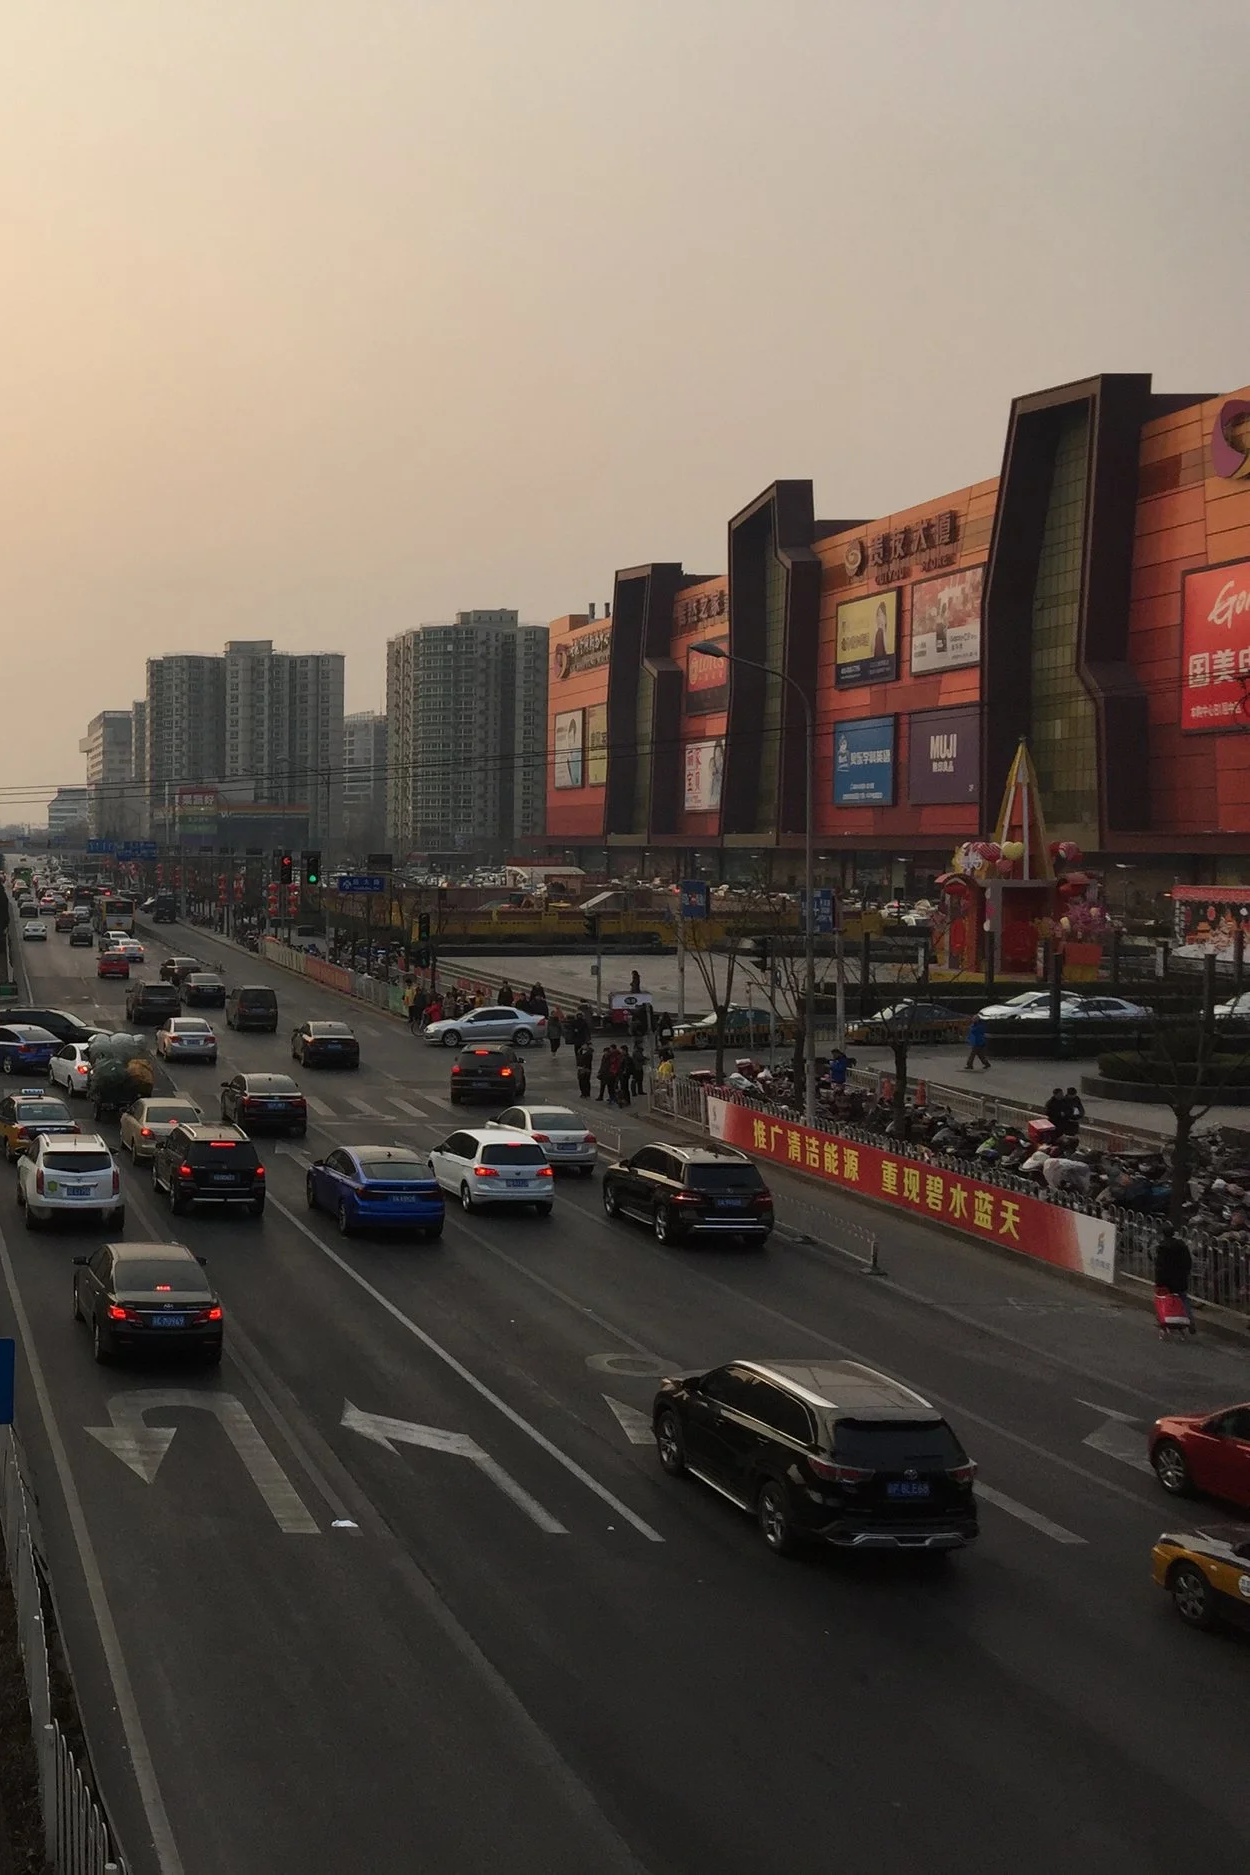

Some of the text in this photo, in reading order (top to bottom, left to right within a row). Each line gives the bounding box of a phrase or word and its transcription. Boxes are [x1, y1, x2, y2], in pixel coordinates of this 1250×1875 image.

[869, 511, 958, 566] 贵友大厦
[930, 734, 957, 759] MUJI
[753, 1118, 1021, 1241] 推广清洁能源 重现碧水蓝天
